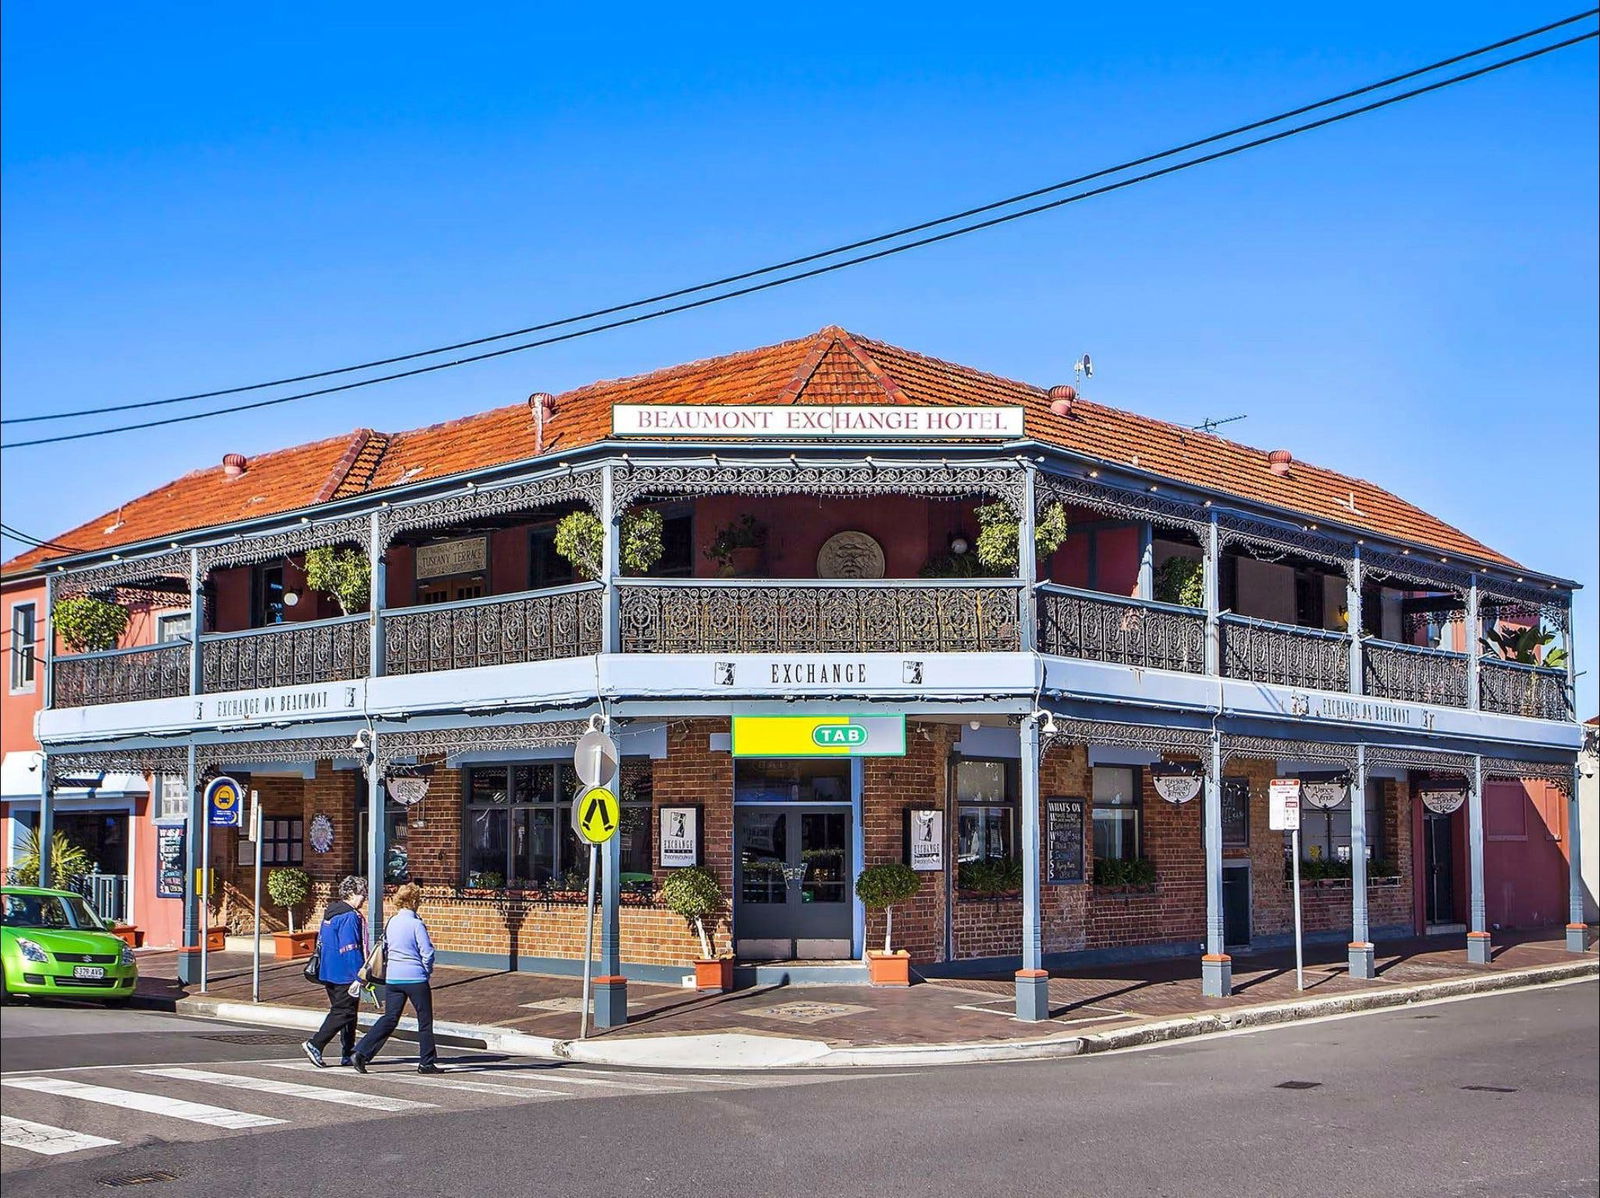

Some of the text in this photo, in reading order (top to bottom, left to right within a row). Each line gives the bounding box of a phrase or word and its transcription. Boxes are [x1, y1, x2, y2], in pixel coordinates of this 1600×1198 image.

[638, 410, 1008, 430] BEAUMONT EXCHANGE HOTEL
[771, 663, 867, 683] EXCHANGE
[217, 691, 329, 717] EXCHANGE ON BEAUMONT
[1323, 698, 1359, 720] EXCHANGE
[1375, 705, 1410, 724] BEAUMONT
[821, 730, 860, 742] TAB
[664, 840, 693, 849] EXCHANGE
